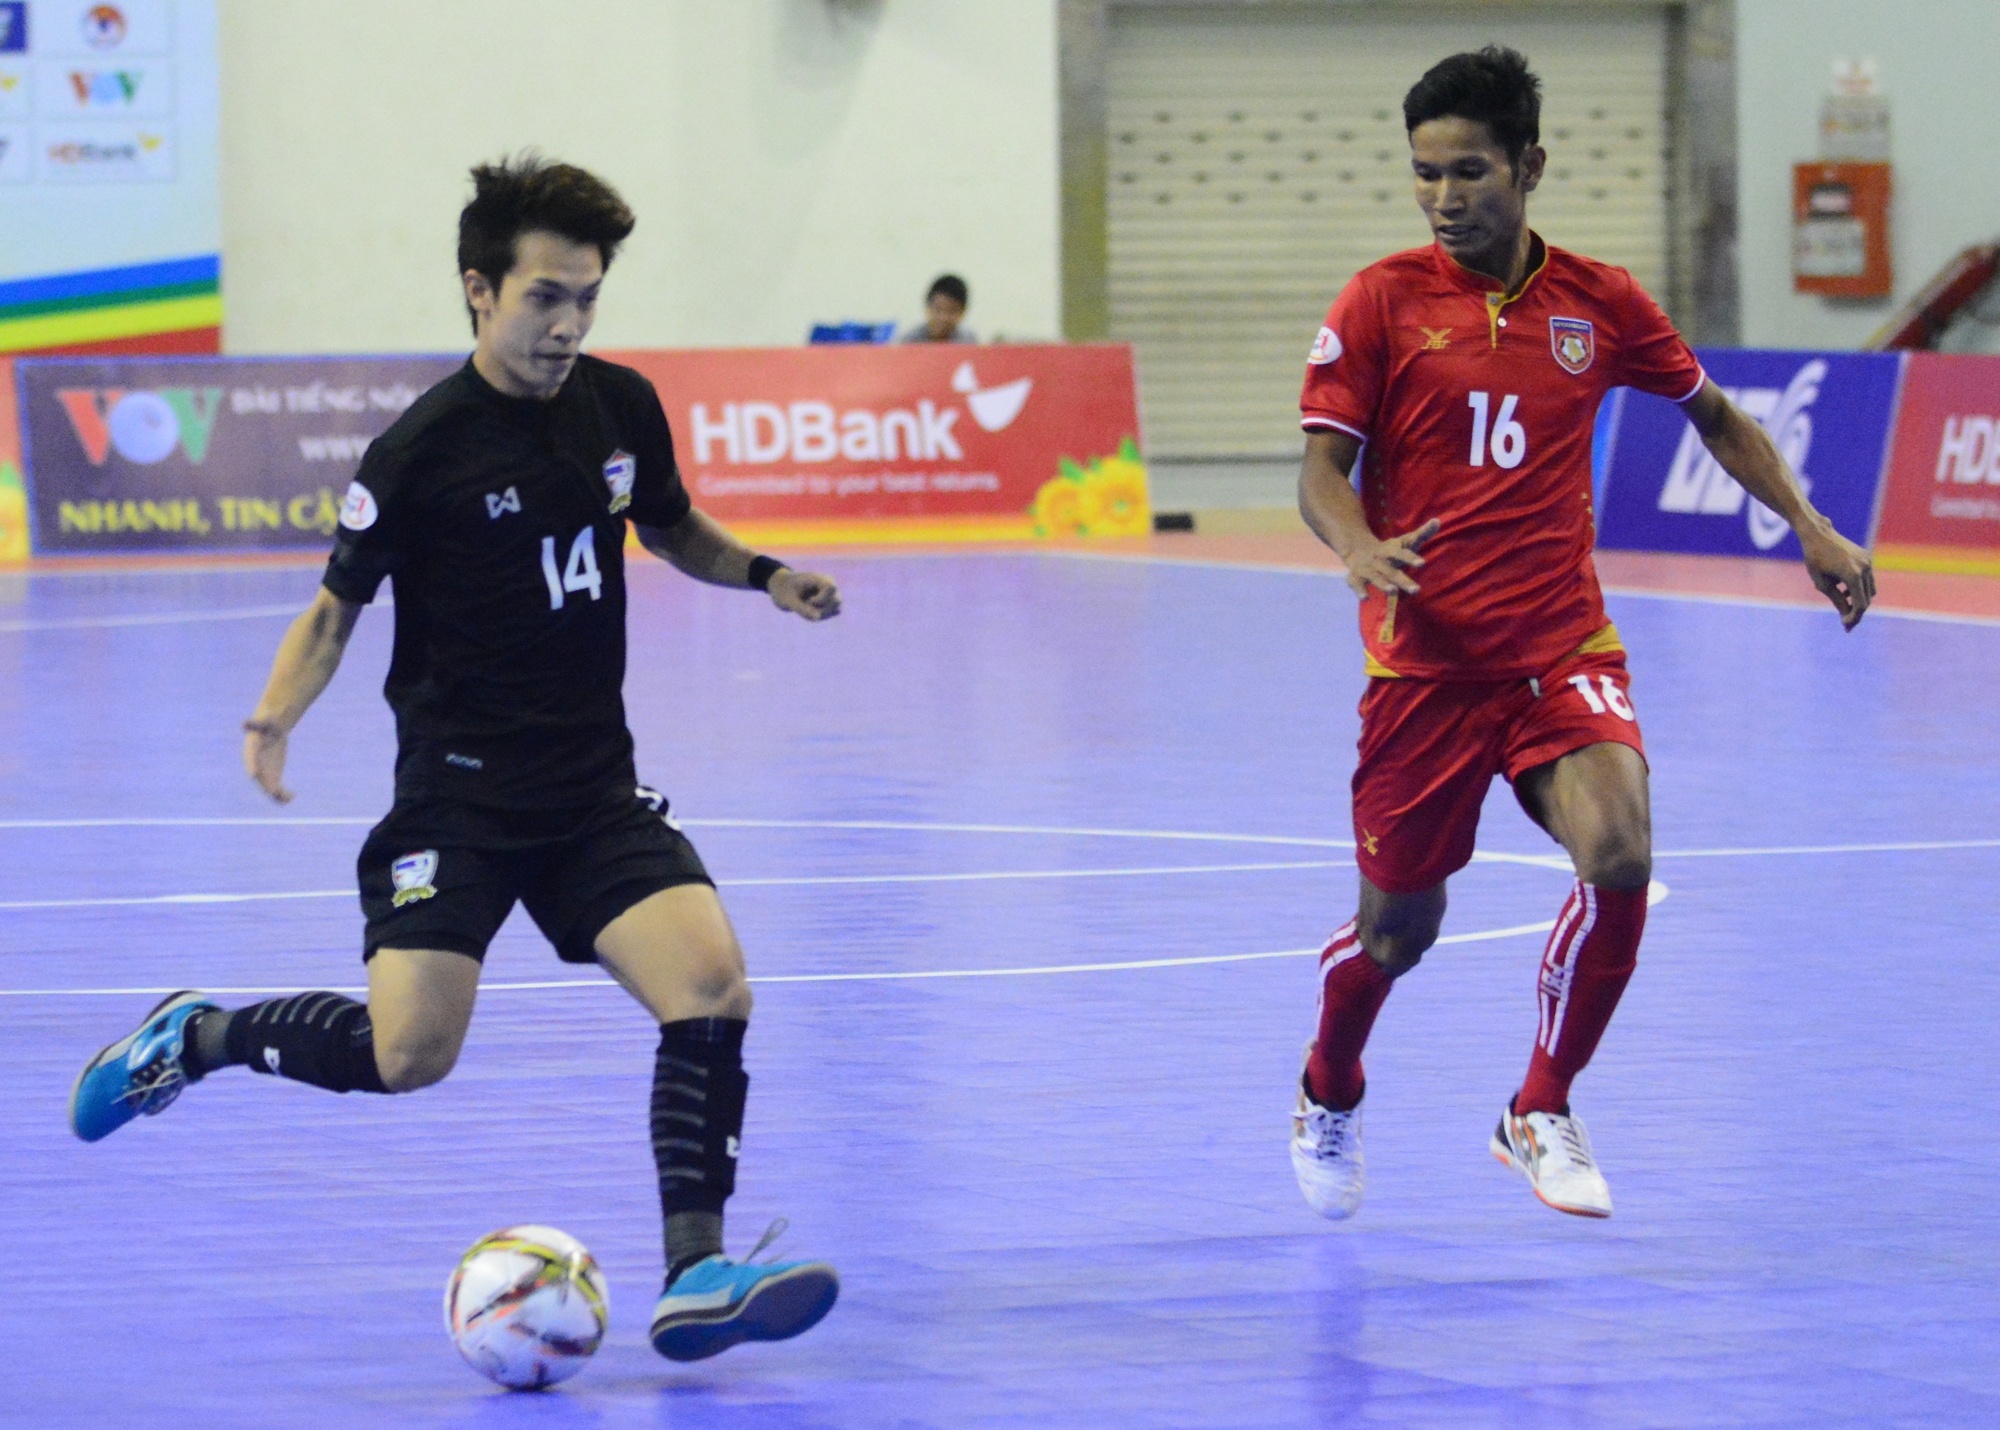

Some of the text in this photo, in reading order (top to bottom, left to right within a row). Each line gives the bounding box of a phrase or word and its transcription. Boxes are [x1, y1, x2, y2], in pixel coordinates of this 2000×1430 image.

[57, 388, 224, 465] VOV
[690, 399, 964, 466] HDBank
[1468, 391, 1526, 469] 16
[220, 495, 282, 531] TIN
[541, 525, 602, 610] 14
[1567, 674, 1635, 722] 16
